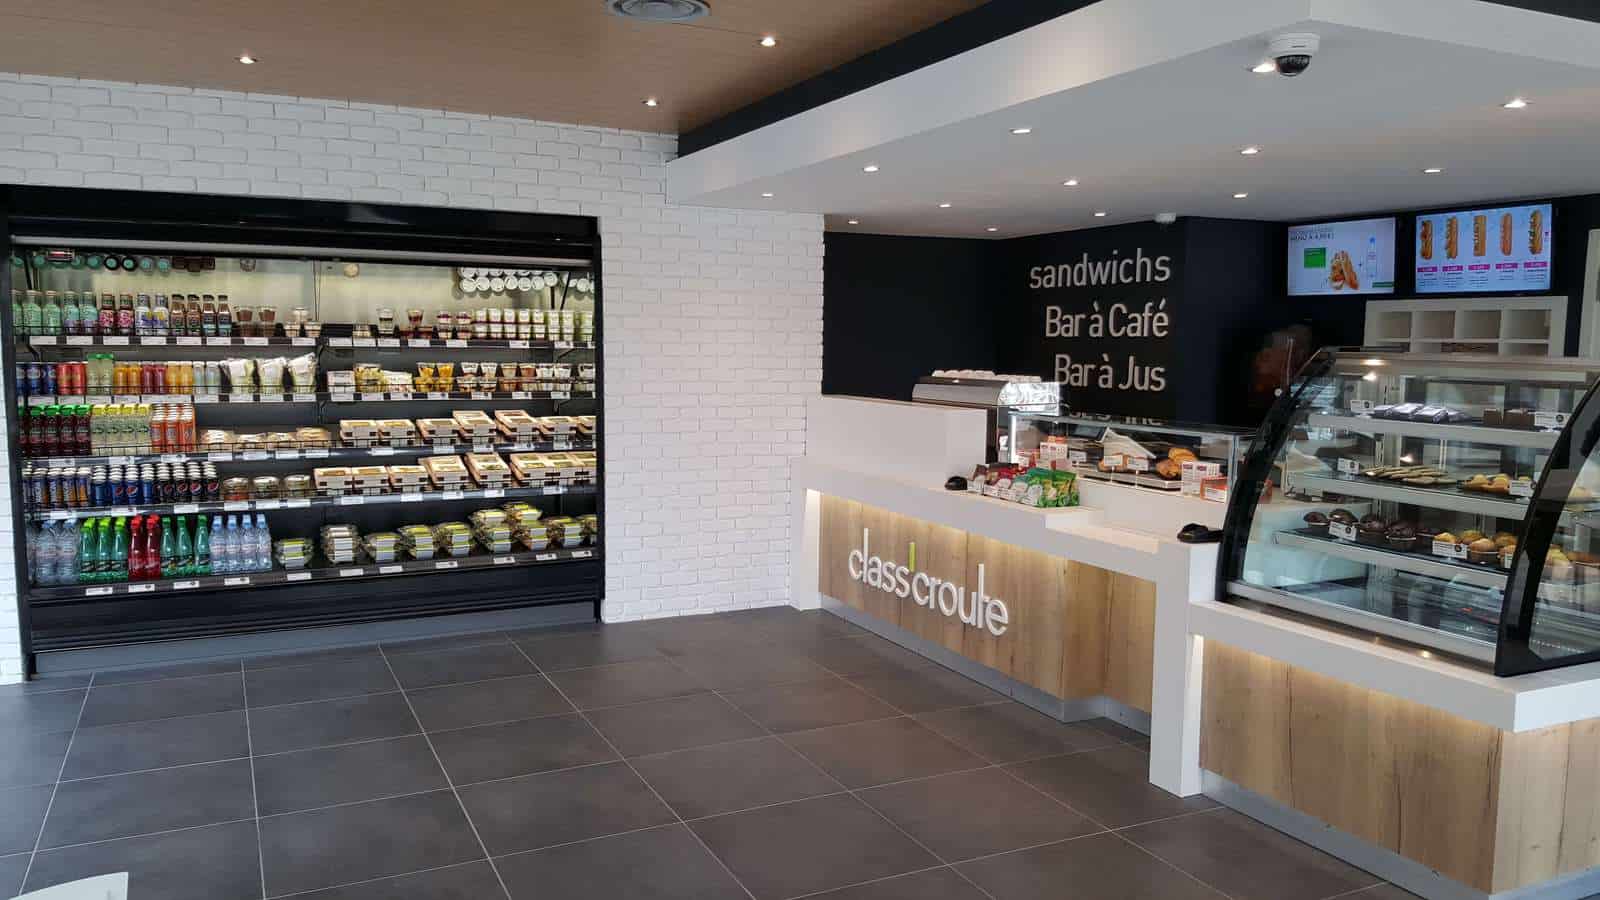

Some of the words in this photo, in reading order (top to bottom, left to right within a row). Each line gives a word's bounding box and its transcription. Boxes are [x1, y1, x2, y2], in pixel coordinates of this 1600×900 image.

[1029, 247, 1171, 289] sandwichs
[1045, 305, 1086, 338] Bar
[1088, 300, 1104, 338] à
[1108, 298, 1169, 338] Café
[1054, 353, 1097, 387] Bar
[1098, 353, 1113, 388] à
[1118, 355, 1166, 392] Jus
